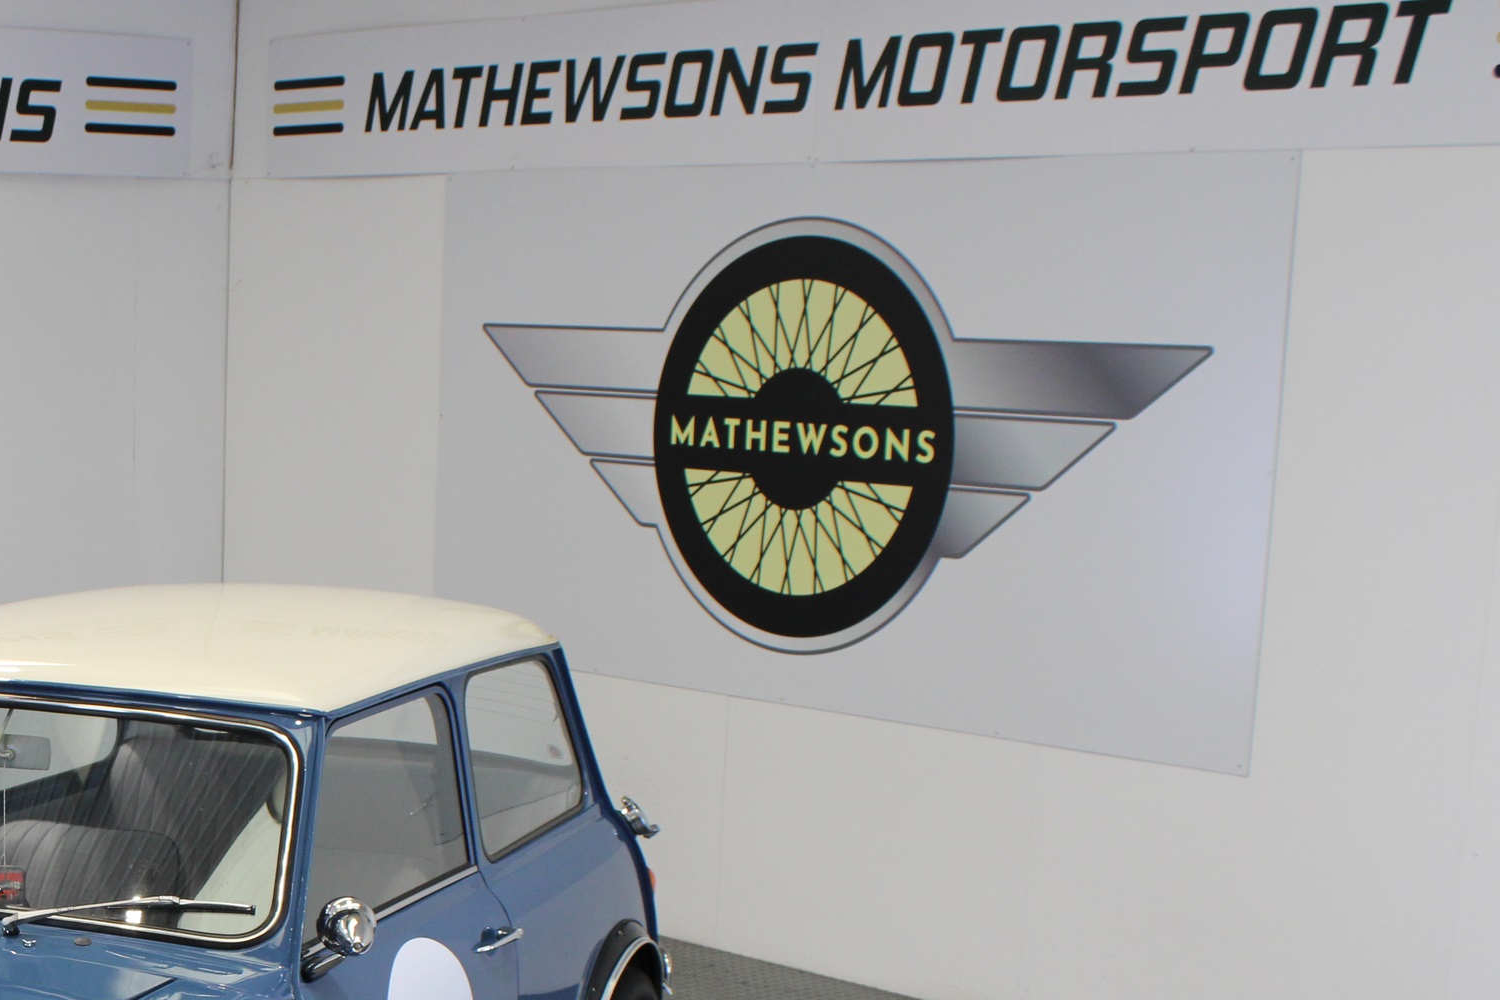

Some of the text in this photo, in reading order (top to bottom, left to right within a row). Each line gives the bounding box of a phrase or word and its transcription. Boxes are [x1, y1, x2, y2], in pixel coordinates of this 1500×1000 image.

[364, 0, 1453, 133] MATHEWSONS MOTORSPORT
[670, 415, 936, 464] MATHEWSONS
